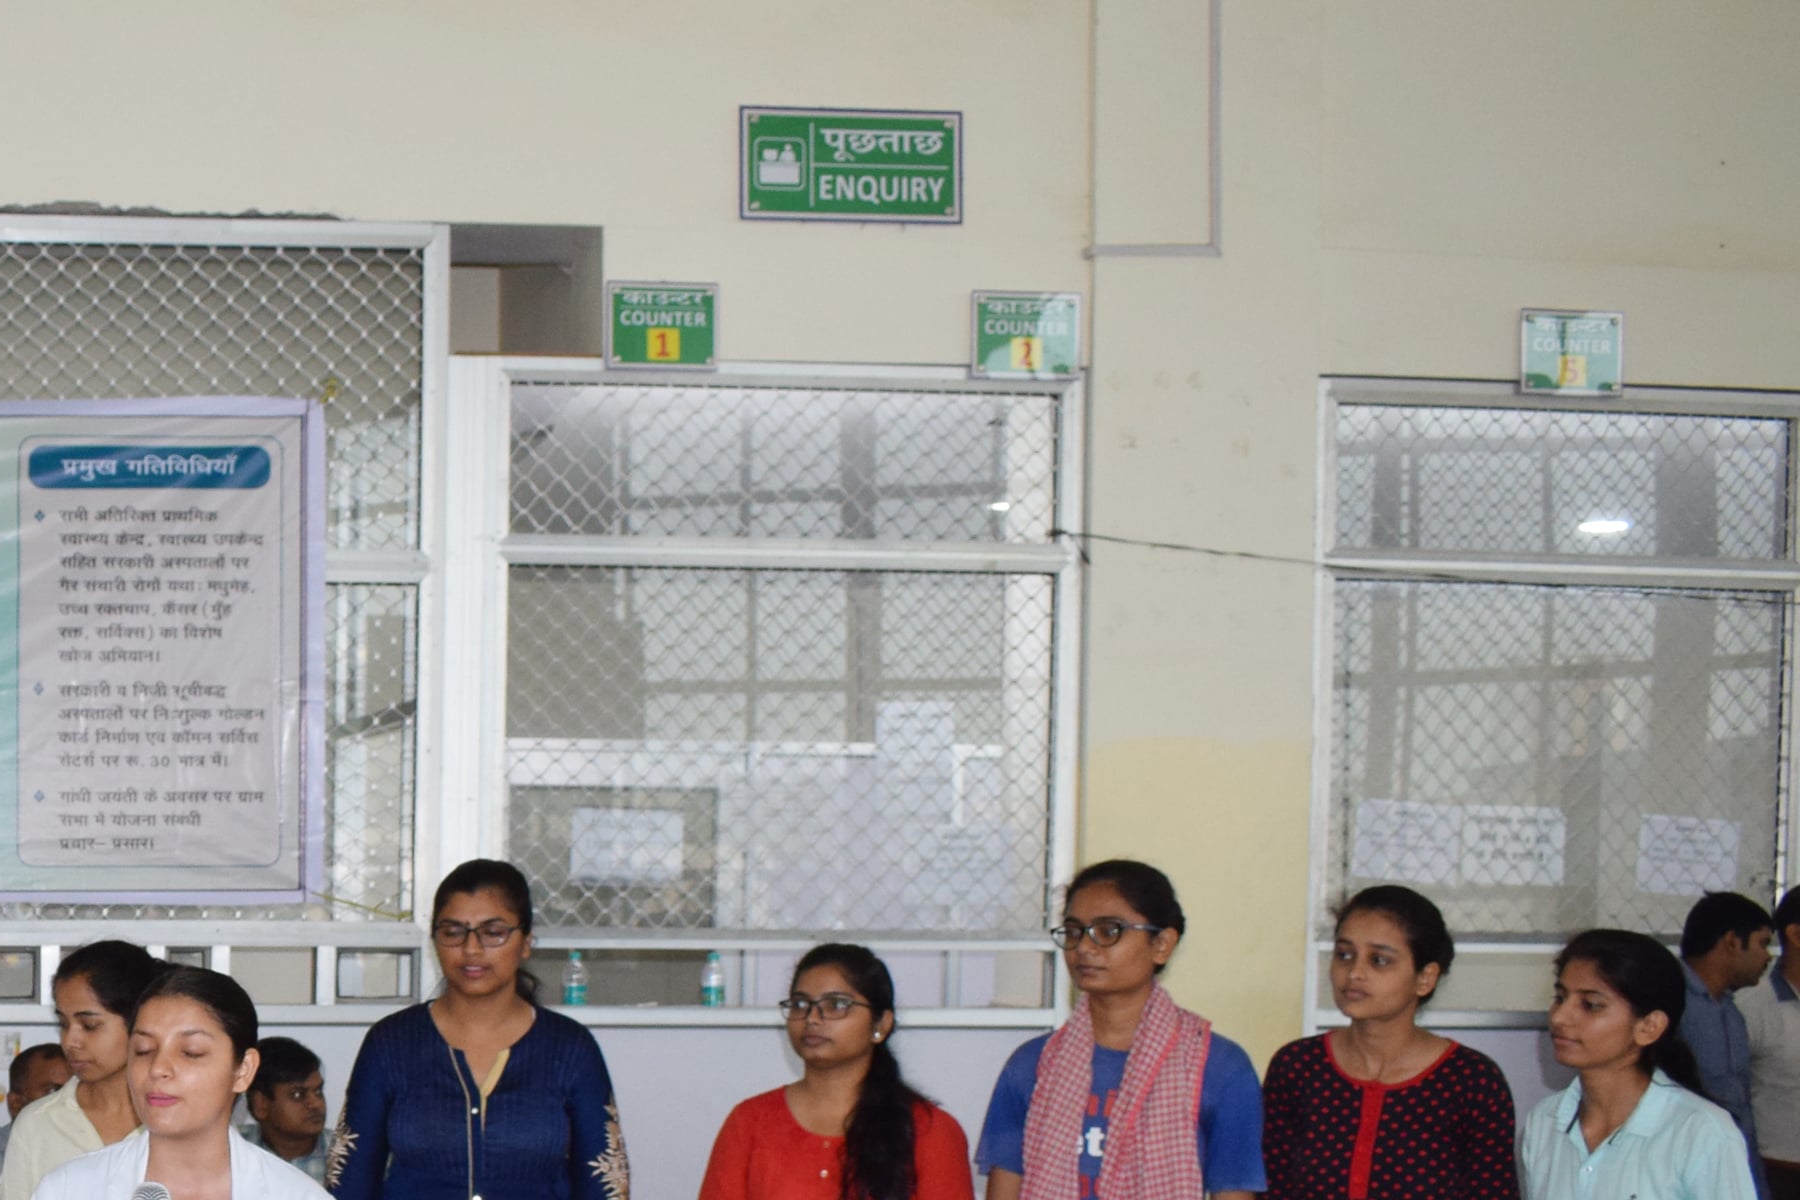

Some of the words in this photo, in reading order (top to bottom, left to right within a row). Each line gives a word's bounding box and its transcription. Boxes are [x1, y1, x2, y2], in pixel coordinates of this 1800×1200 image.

[819, 128, 944, 162] पूछताछ
[819, 174, 945, 205] ENQUIRY
[620, 310, 707, 326] COUNTER
[984, 320, 1068, 336] COUNTER
[656, 333, 670, 358] 1
[1533, 338, 1610, 355] COUNTER
[61, 458, 117, 481] प्रमुख
[126, 454, 237, 476] गतिविधियाँ
